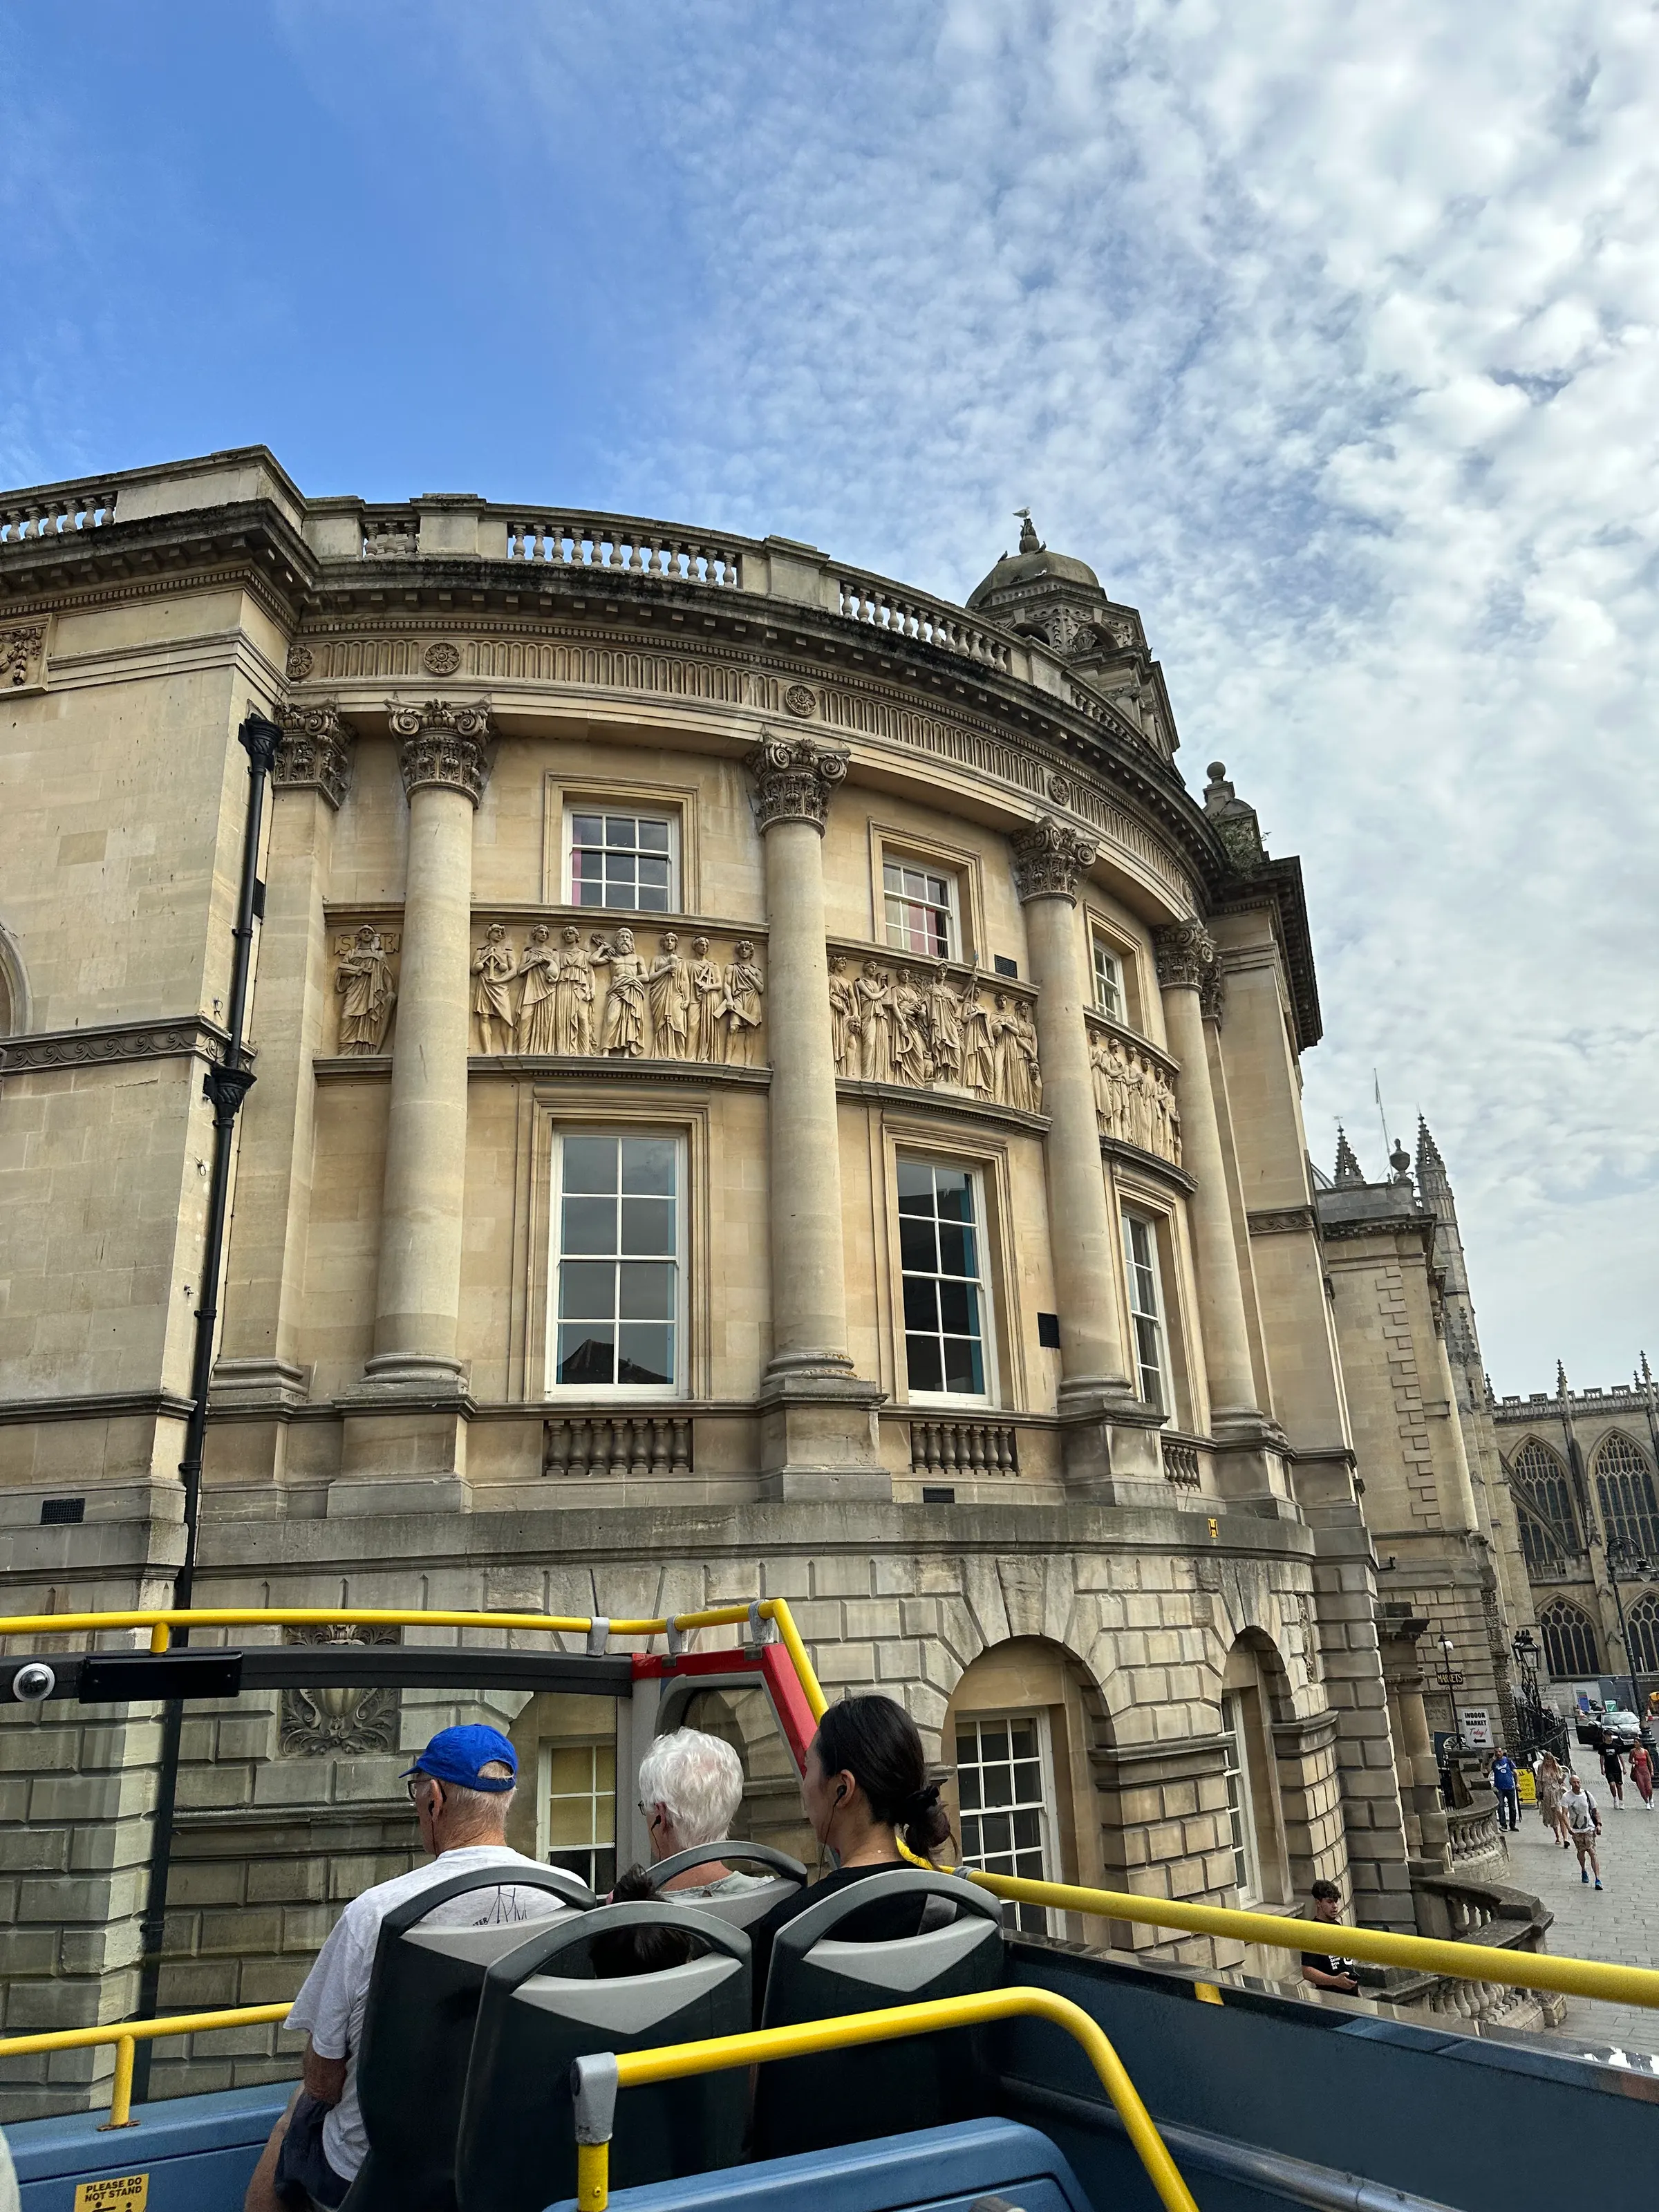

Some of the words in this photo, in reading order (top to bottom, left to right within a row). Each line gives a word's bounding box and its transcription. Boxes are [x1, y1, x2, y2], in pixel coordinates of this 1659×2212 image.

[1208, 1519, 1218, 1537] H
[1469, 1728, 1488, 1737] Today!
[473, 1917, 488, 1926] TER
[86, 2180, 125, 2193] PLEASE
[127, 2177, 142, 2186] DO
[84, 2191, 106, 2202] NOT
[109, 2186, 142, 2198] STAND
